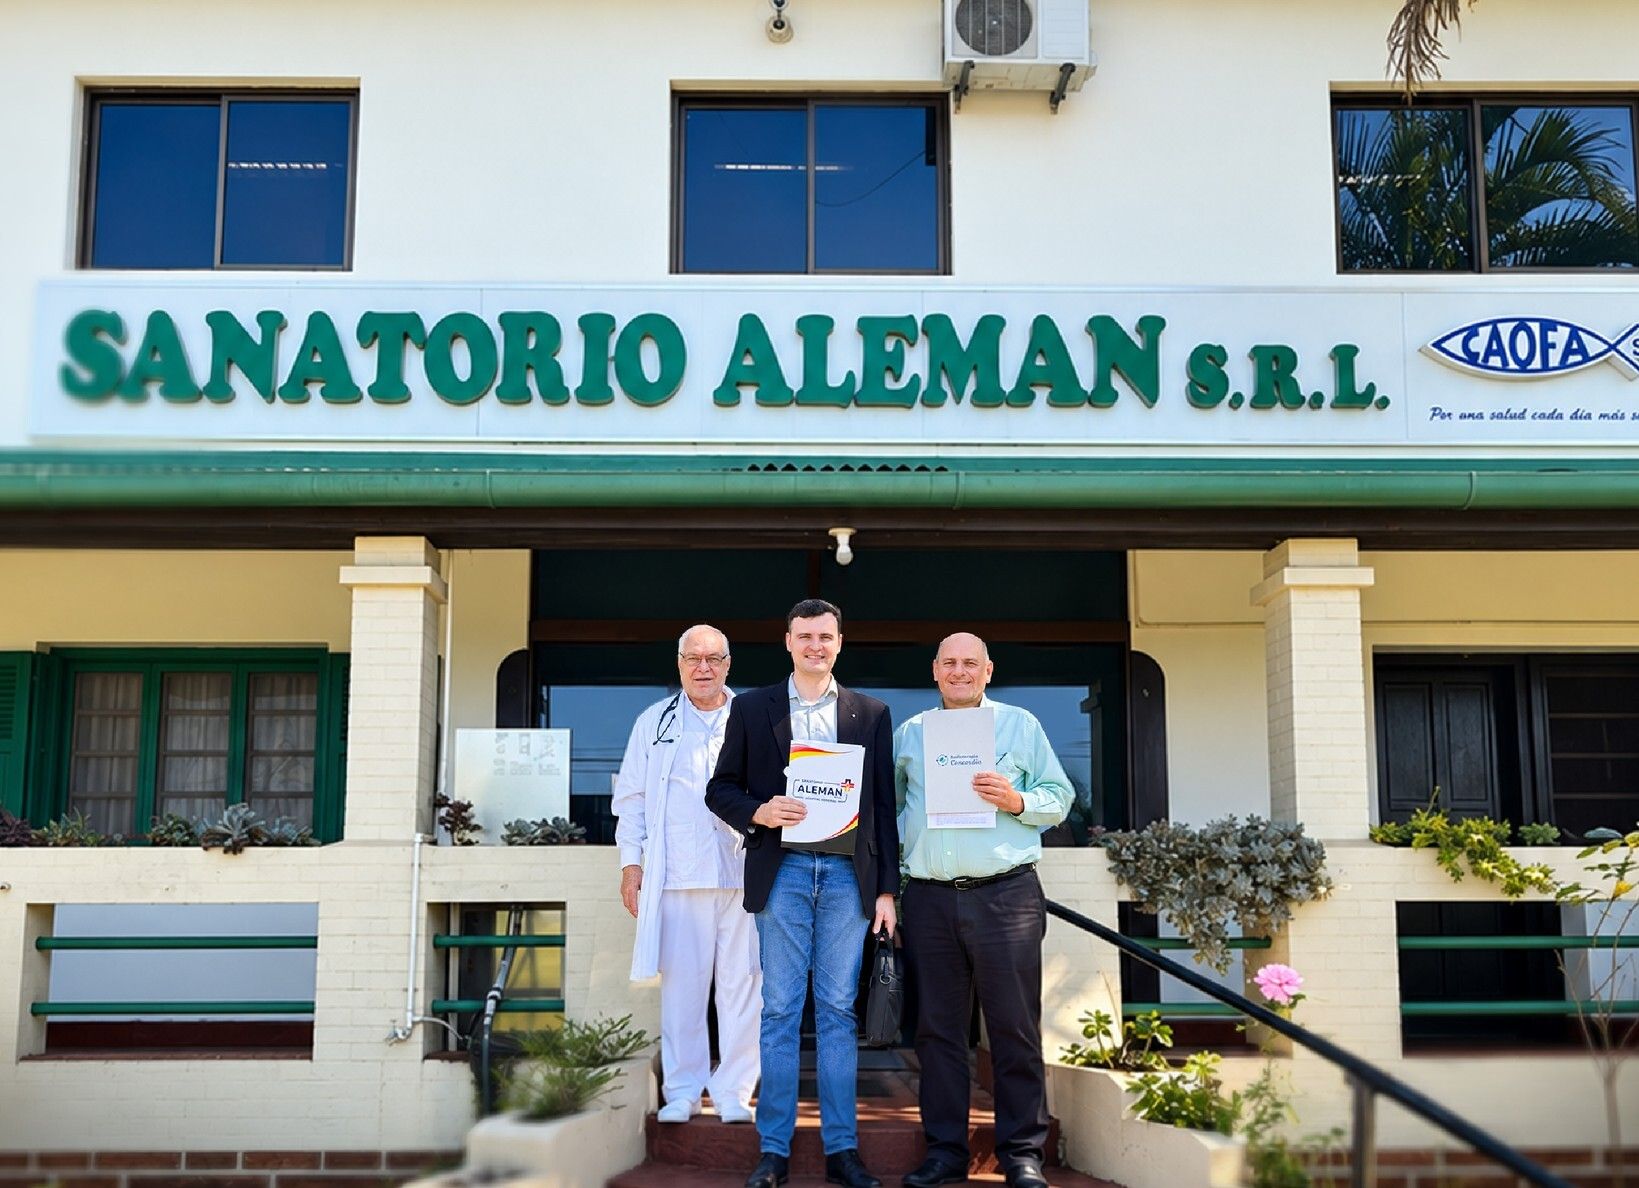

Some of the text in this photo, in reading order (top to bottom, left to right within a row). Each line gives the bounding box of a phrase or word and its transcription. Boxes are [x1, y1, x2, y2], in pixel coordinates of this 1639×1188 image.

[62, 309, 1390, 410] SANATORIO ALEMAN S.R.L.
[1462, 320, 1590, 370] CAOFA
[1429, 406, 1453, 421] Por
[1459, 411, 1485, 421] una
[1490, 408, 1527, 421] salud
[1531, 408, 1564, 421] cada
[797, 784, 843, 797] ALEMAN
